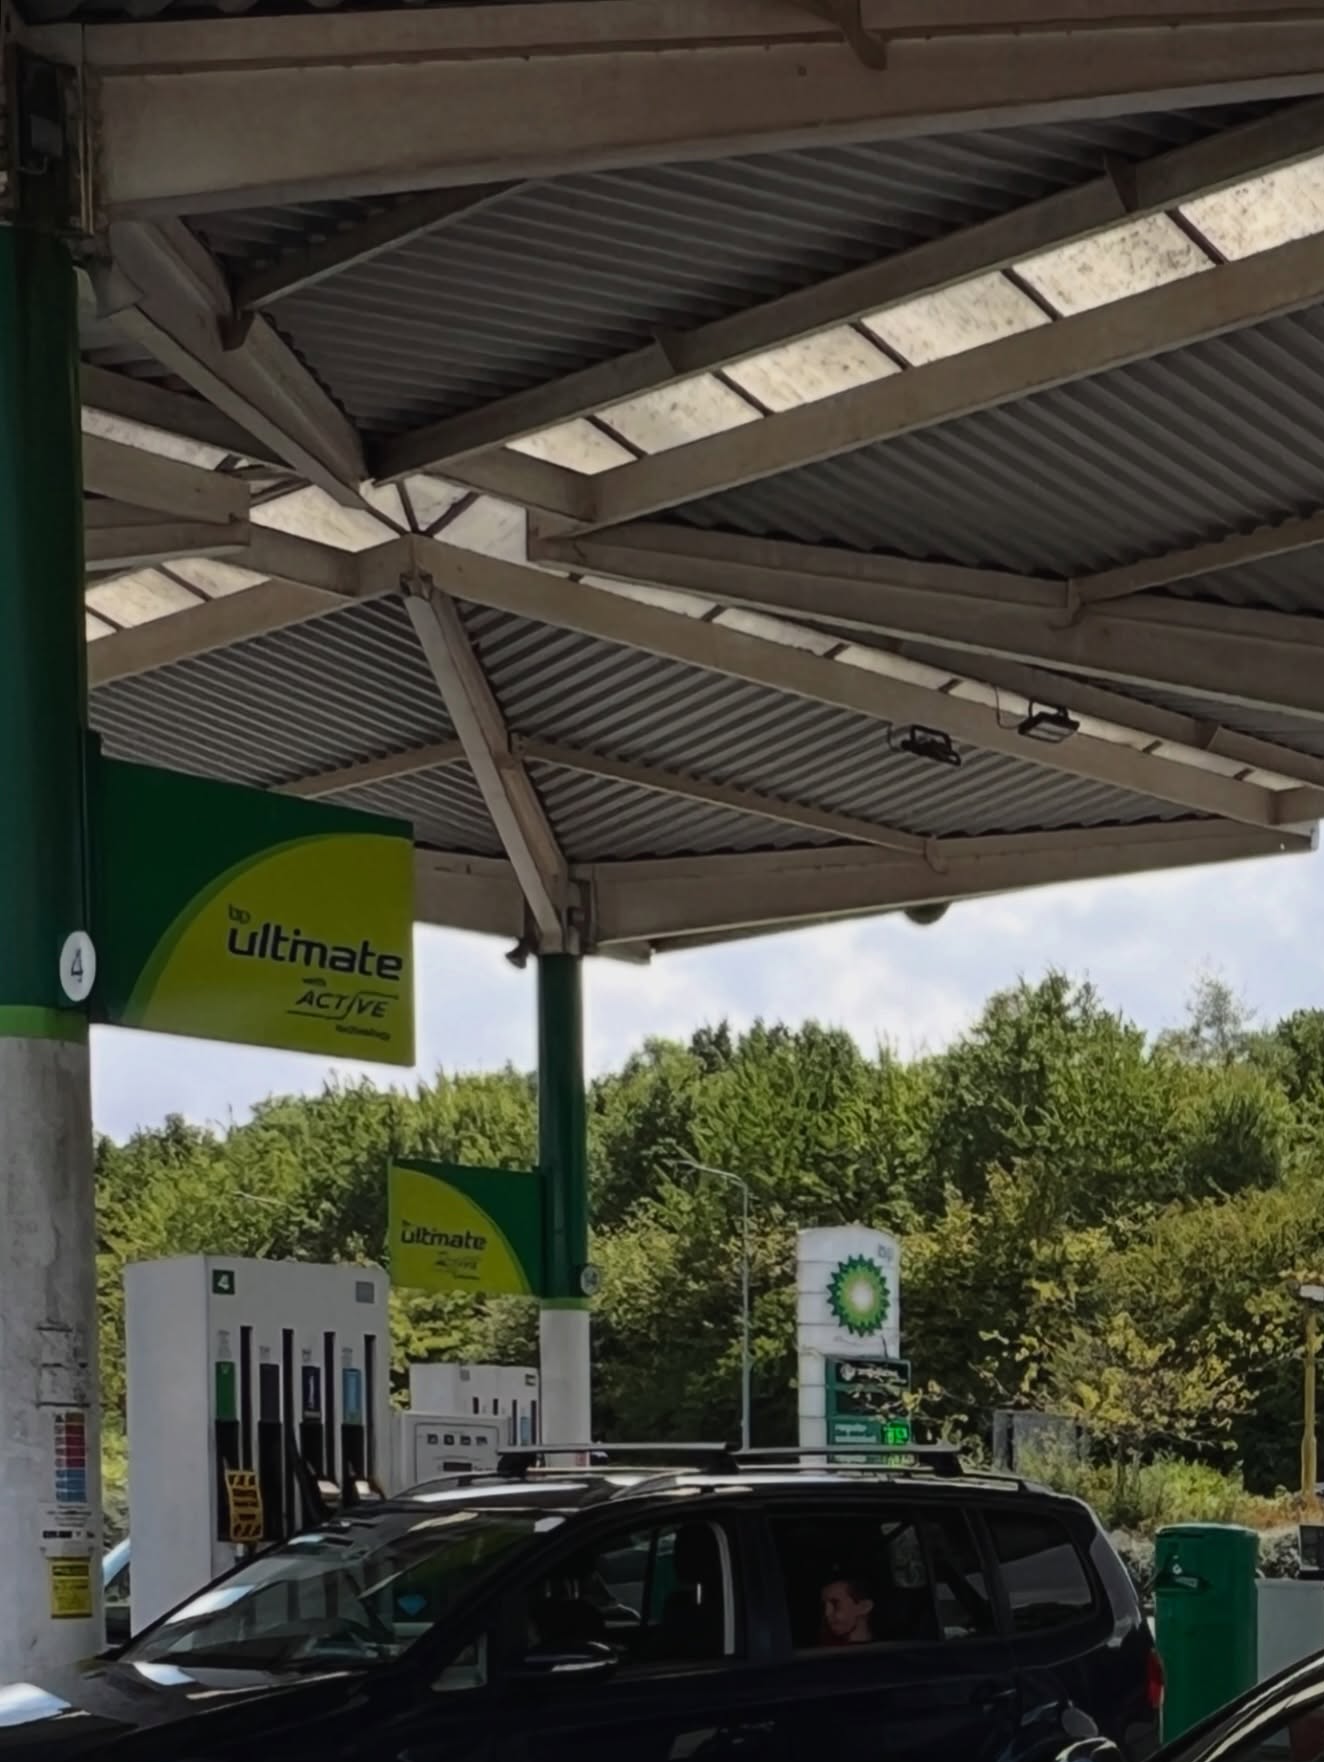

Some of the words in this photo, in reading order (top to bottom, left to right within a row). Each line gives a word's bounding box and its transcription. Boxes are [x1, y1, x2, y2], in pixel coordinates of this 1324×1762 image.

[71, 947, 84, 983] 4
[228, 922, 402, 981] ultimate
[296, 989, 388, 1020] ACTIVE
[401, 1226, 488, 1250] ultimate
[217, 1274, 231, 1290] 4
